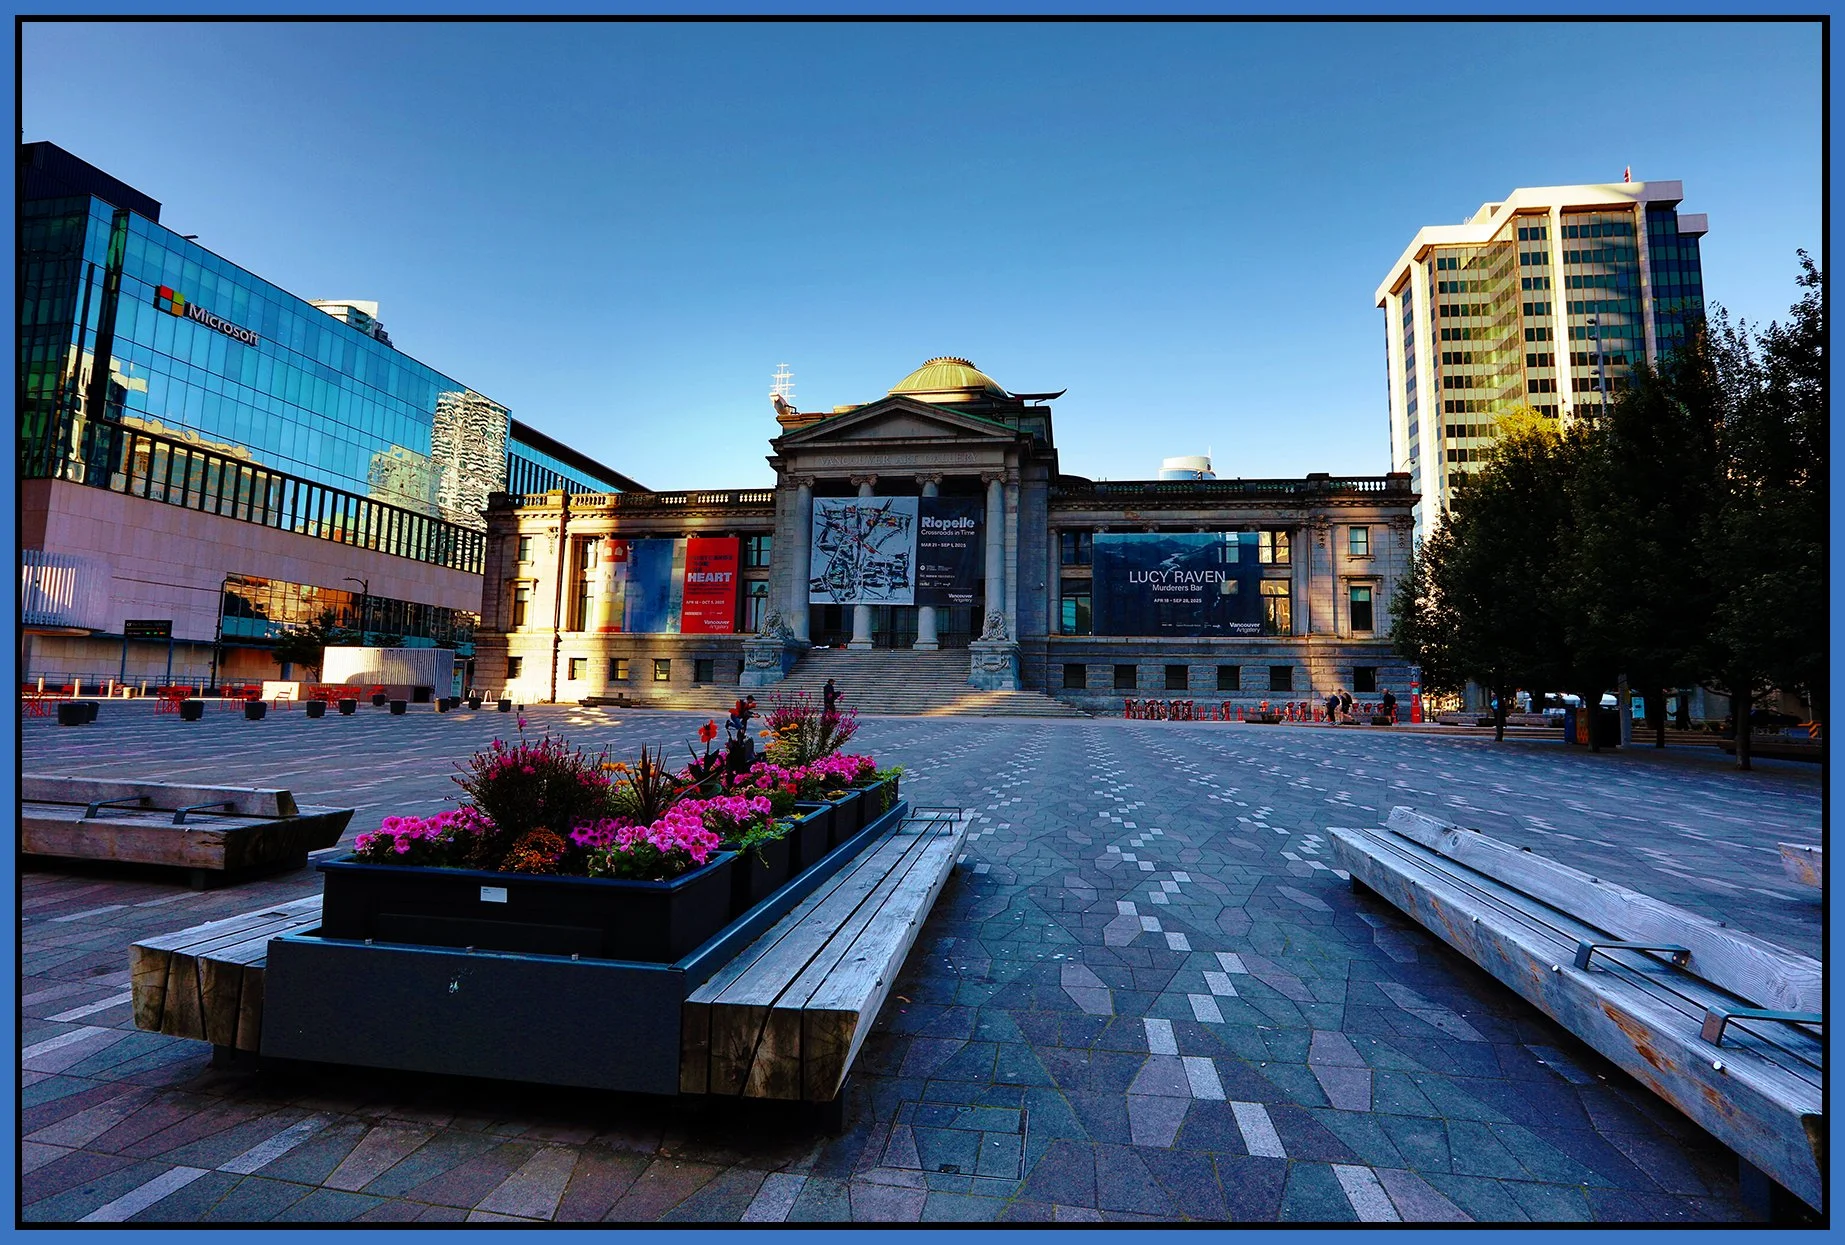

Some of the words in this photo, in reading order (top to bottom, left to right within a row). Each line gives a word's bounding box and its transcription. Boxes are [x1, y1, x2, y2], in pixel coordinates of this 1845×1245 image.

[188, 302, 259, 346] Microsoft
[819, 455, 890, 465] VANCOUVER
[895, 455, 918, 464] ART
[924, 452, 978, 464] GALLERY
[921, 516, 975, 530] Riopelle
[687, 573, 732, 582] HEART
[1129, 571, 1169, 583] LUCY
[1174, 571, 1226, 583] RAVEN
